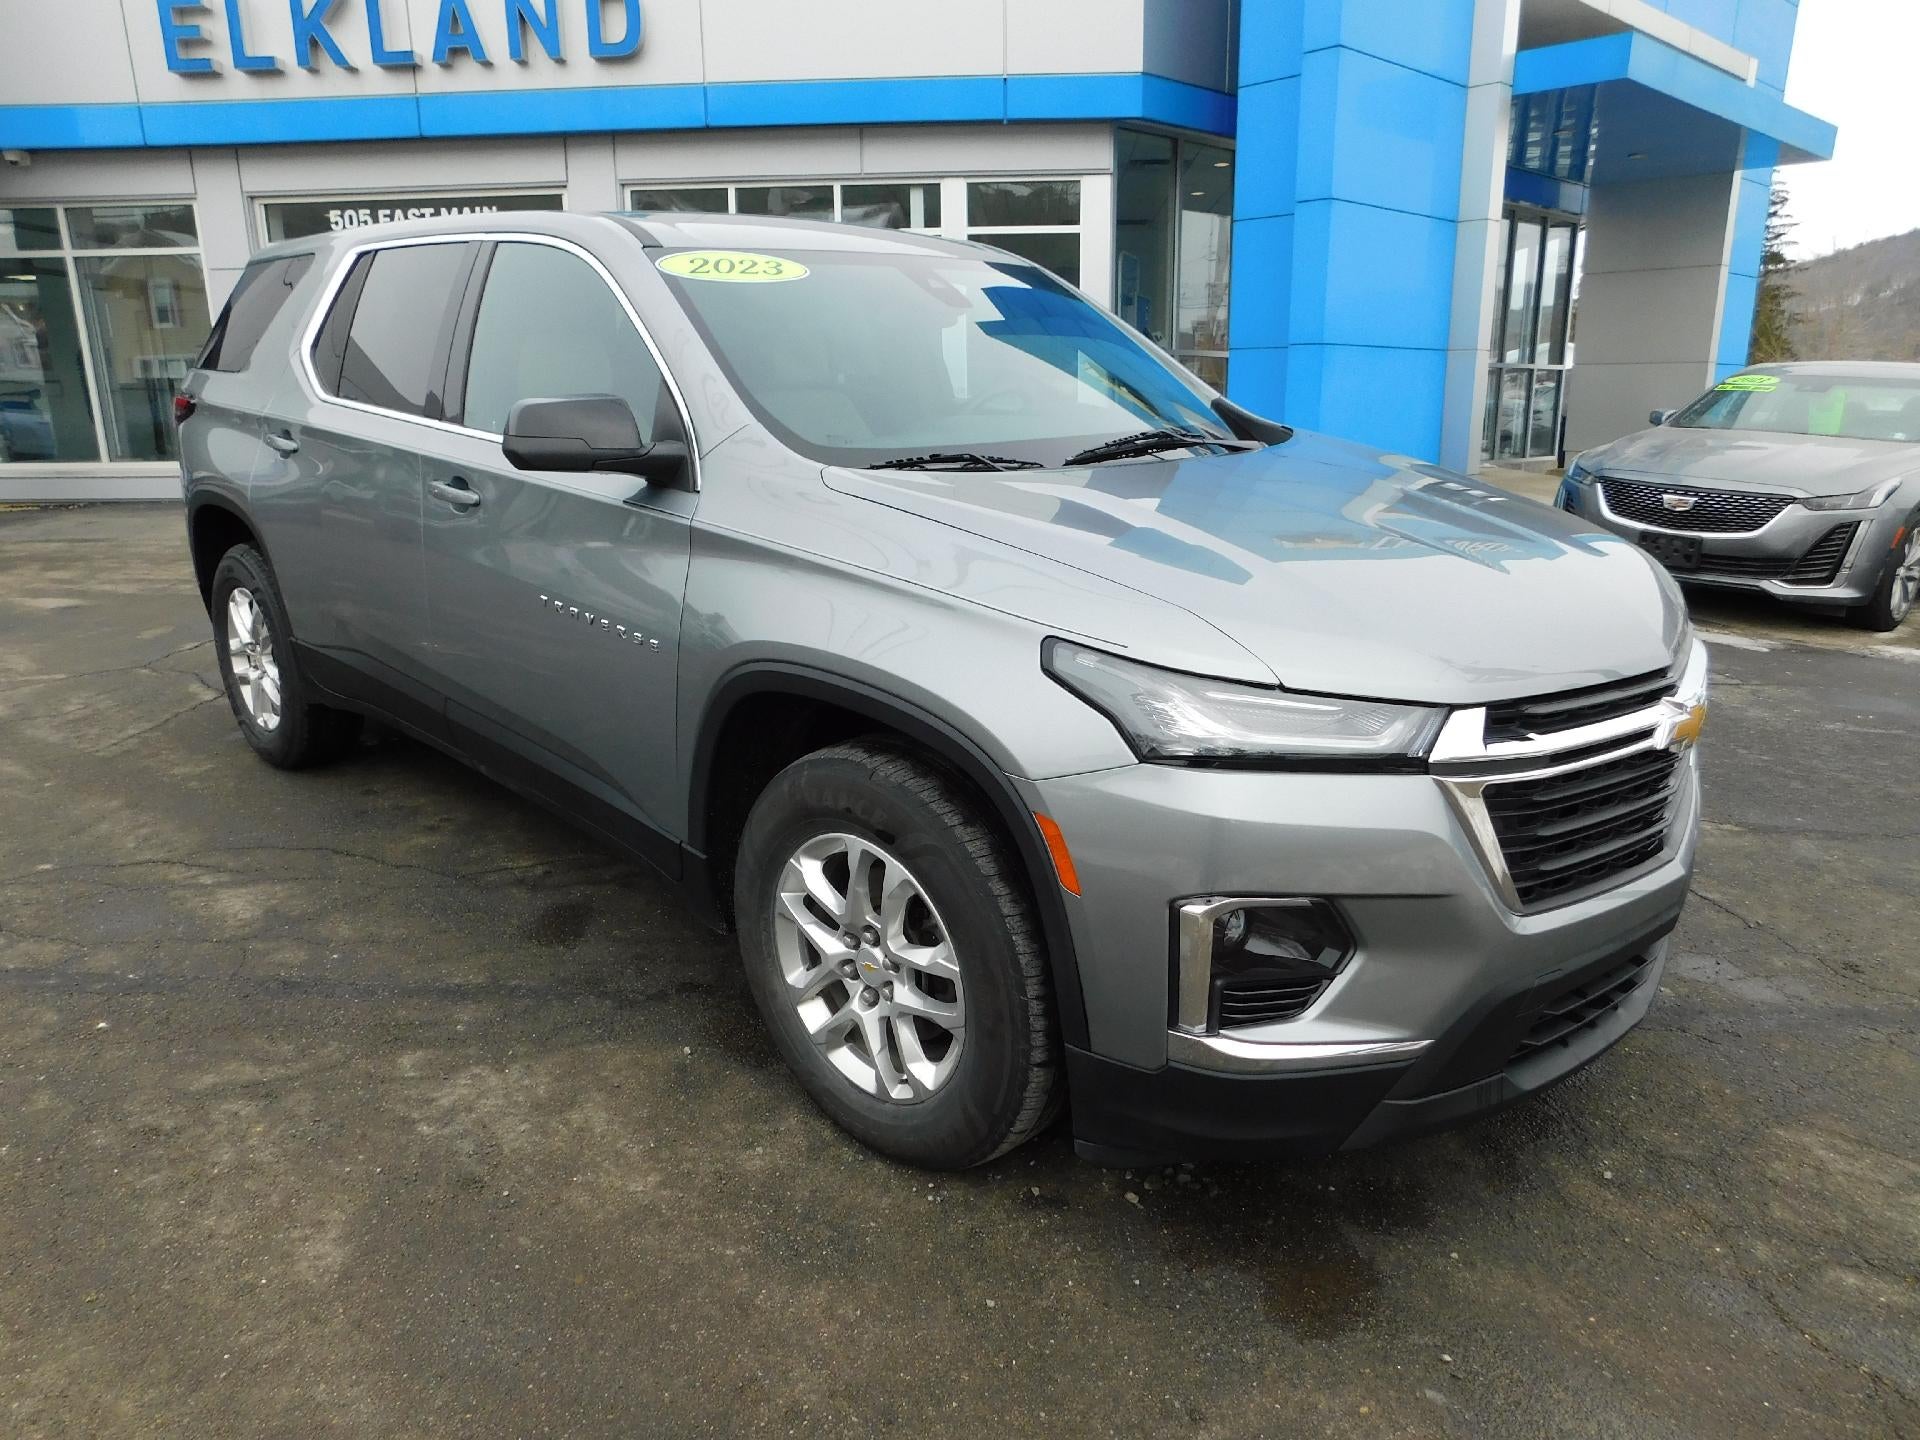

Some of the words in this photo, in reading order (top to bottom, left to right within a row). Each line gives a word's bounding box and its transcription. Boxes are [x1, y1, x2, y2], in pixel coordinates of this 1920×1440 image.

[157, 0, 642, 74] ELKLAND
[329, 208, 373, 231] 505
[689, 257, 783, 276] 2023
[539, 594, 660, 654] TRAVERSE
